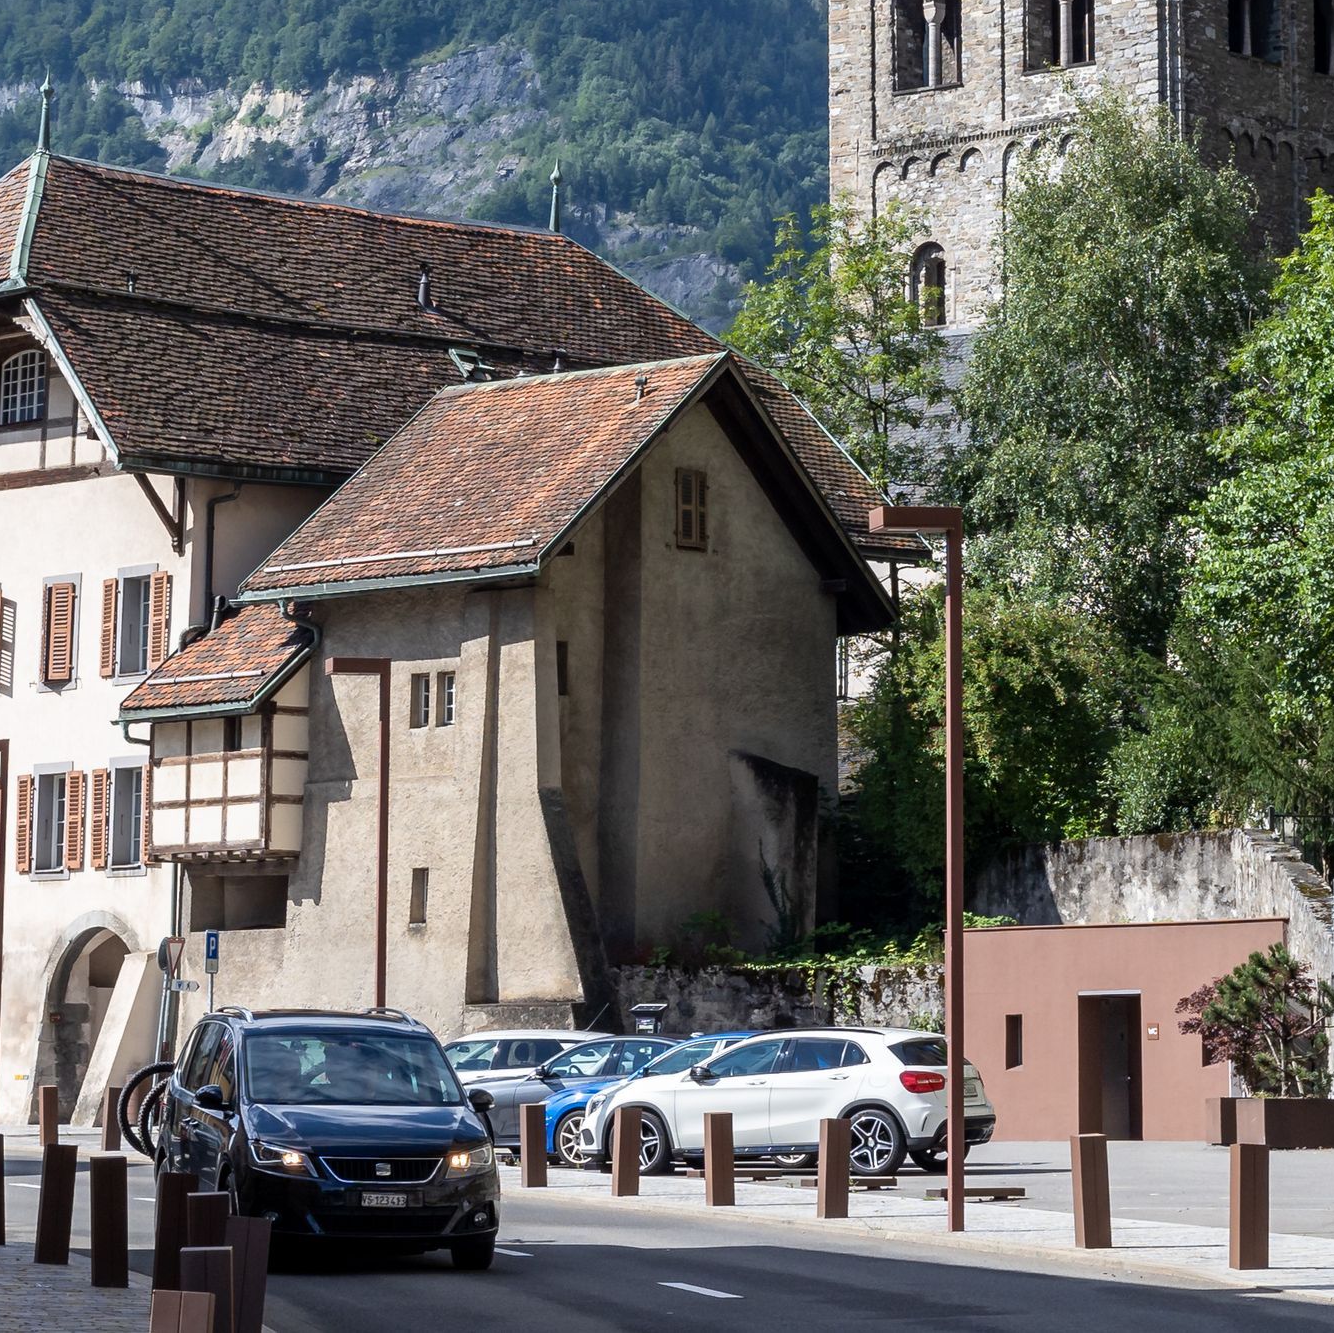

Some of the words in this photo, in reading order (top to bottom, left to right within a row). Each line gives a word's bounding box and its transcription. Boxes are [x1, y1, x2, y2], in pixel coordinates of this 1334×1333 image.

[210, 937, 216, 956] P
[1148, 1027, 1158, 1035] WC
[362, 1196, 373, 1205] VS
